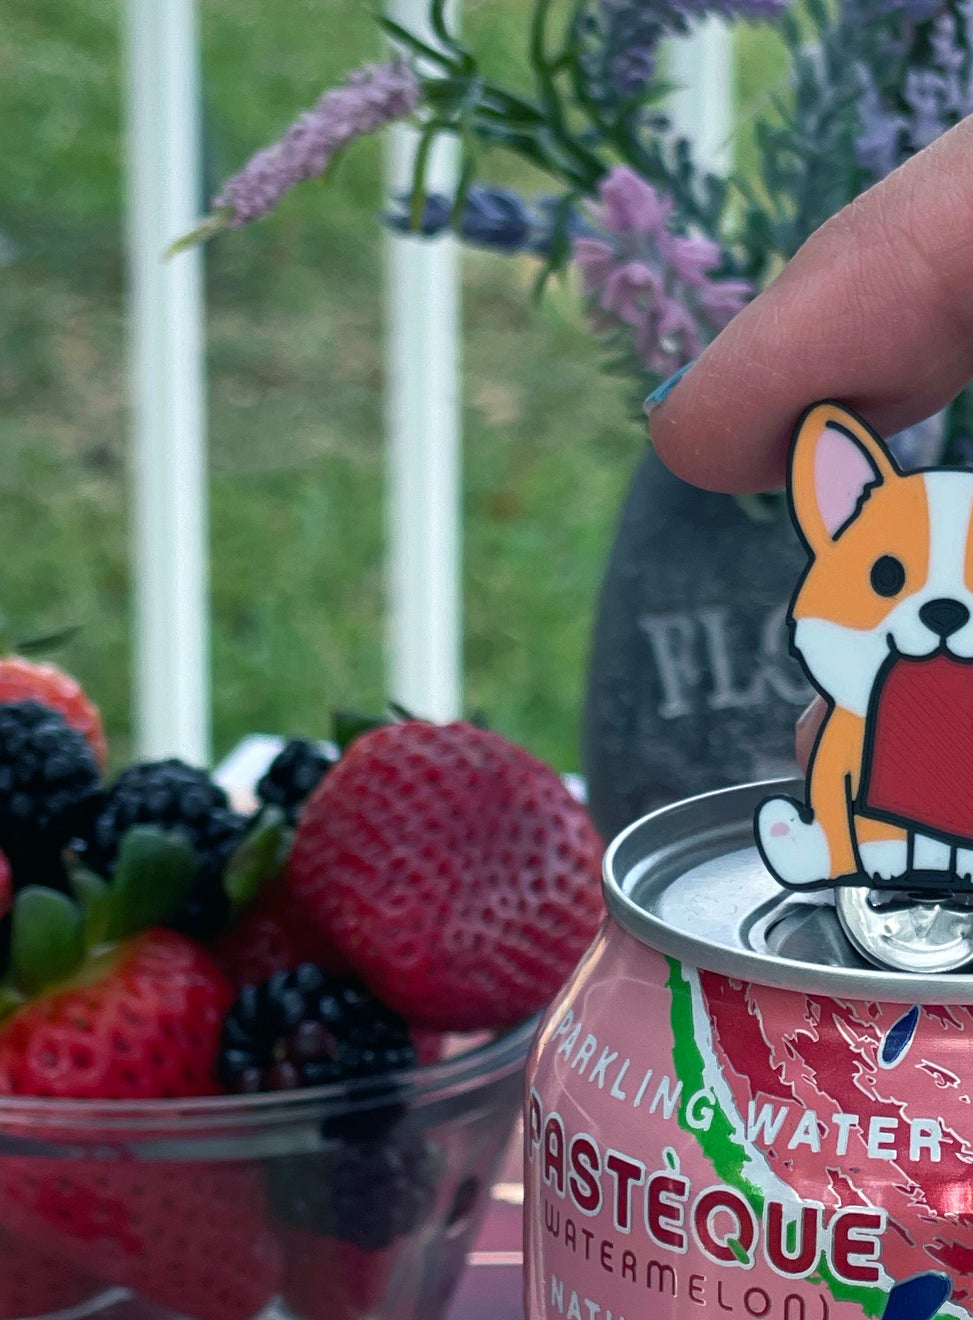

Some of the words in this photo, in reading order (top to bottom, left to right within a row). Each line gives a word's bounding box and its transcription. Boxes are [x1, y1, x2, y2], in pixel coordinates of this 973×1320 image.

[551, 1008, 717, 1132] PARKLING
[747, 1098, 946, 1164] WATER
[529, 1085, 894, 1291] PASTÈQUE
